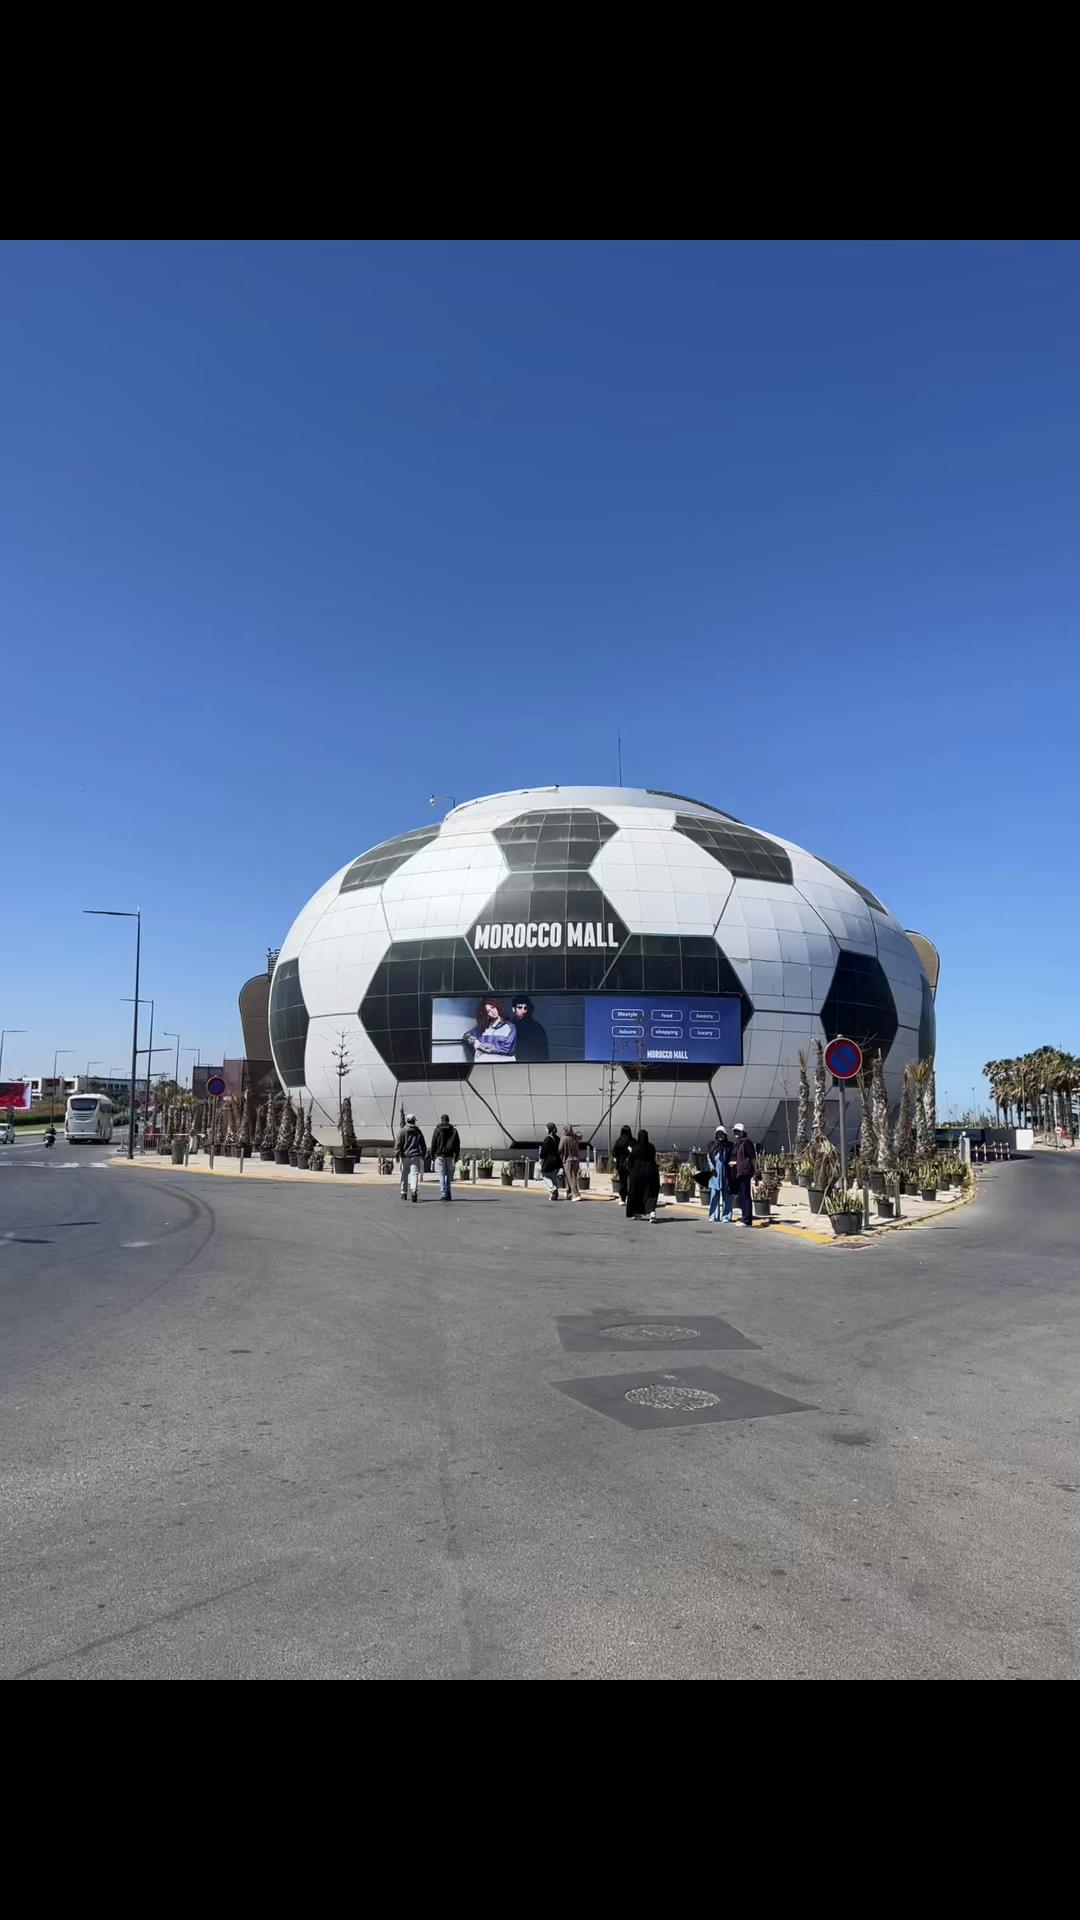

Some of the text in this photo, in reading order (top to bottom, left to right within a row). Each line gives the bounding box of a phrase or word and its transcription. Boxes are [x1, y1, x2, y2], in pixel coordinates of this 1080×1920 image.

[474, 922, 619, 949] MOROCCO MALL
[647, 1050, 688, 1059] MOROCCO MALL
